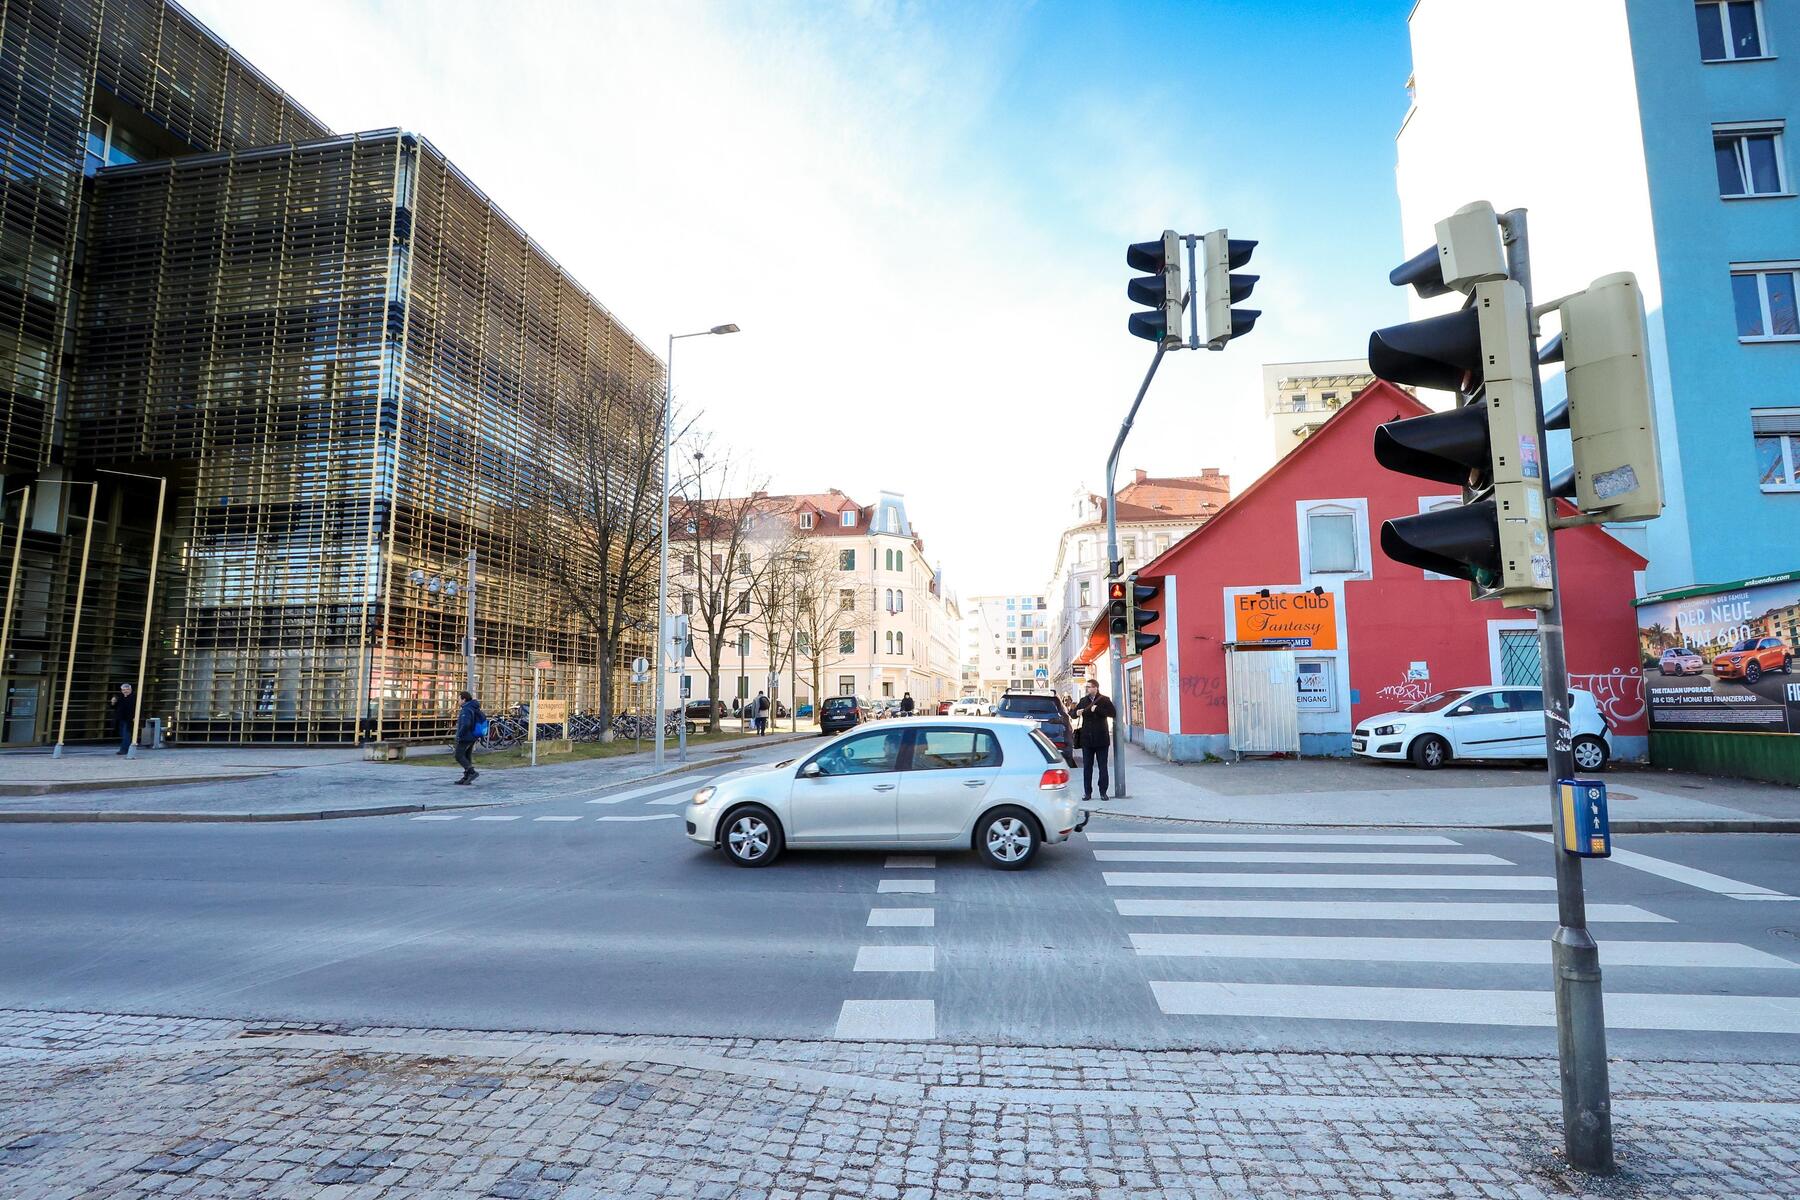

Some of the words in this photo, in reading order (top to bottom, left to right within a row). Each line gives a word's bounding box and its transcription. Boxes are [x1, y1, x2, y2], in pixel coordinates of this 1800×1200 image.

[1240, 596, 1287, 611] Erotic
[1293, 595, 1329, 609] Club
[1728, 592, 1749, 601] FAMILIE
[1678, 609, 1706, 627] DER
[1711, 601, 1753, 624] NEUE
[1246, 612, 1324, 636] Fantasy
[1682, 629, 1711, 649] FIAT
[1717, 624, 1751, 646] 600
[1296, 695, 1327, 703] EINGANG
[1713, 695, 1757, 703] FINANZIERUNG
